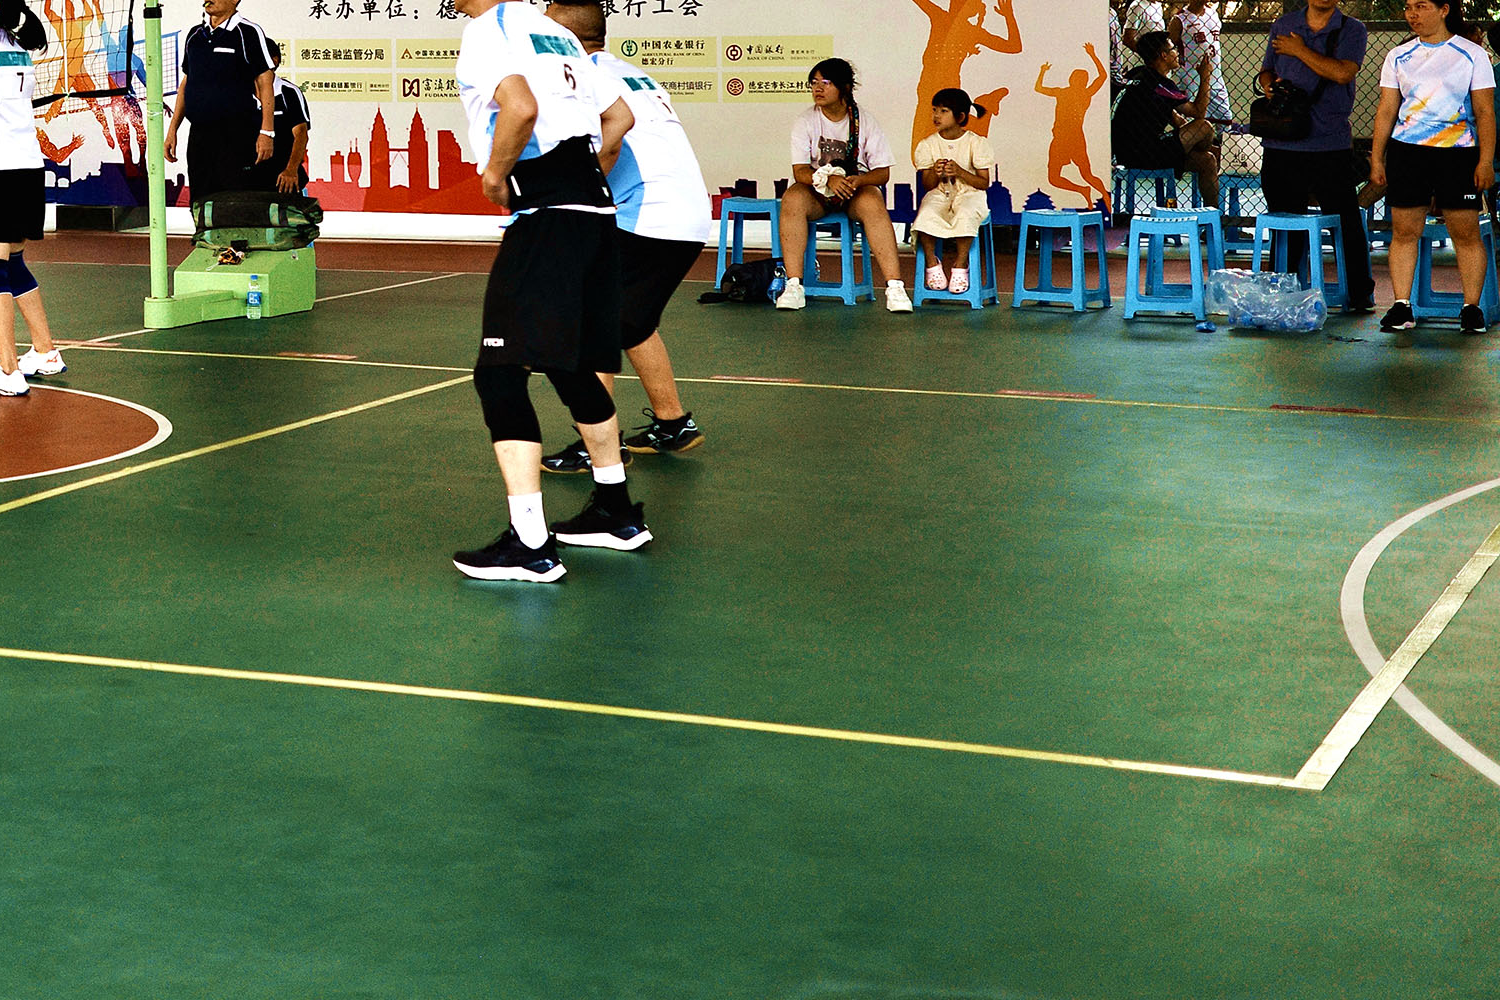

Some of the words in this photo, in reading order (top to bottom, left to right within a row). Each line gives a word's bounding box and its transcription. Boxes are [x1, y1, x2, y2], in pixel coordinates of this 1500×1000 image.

[641, 40, 705, 50] 中国农业银行
[746, 44, 784, 55] 中国银行
[301, 48, 385, 60] 德宏金融监管分局
[641, 57, 674, 66] 德宏分行
[16, 72, 24, 92] 7
[563, 63, 576, 91] 6
[659, 81, 713, 91] 农商村镇银行
